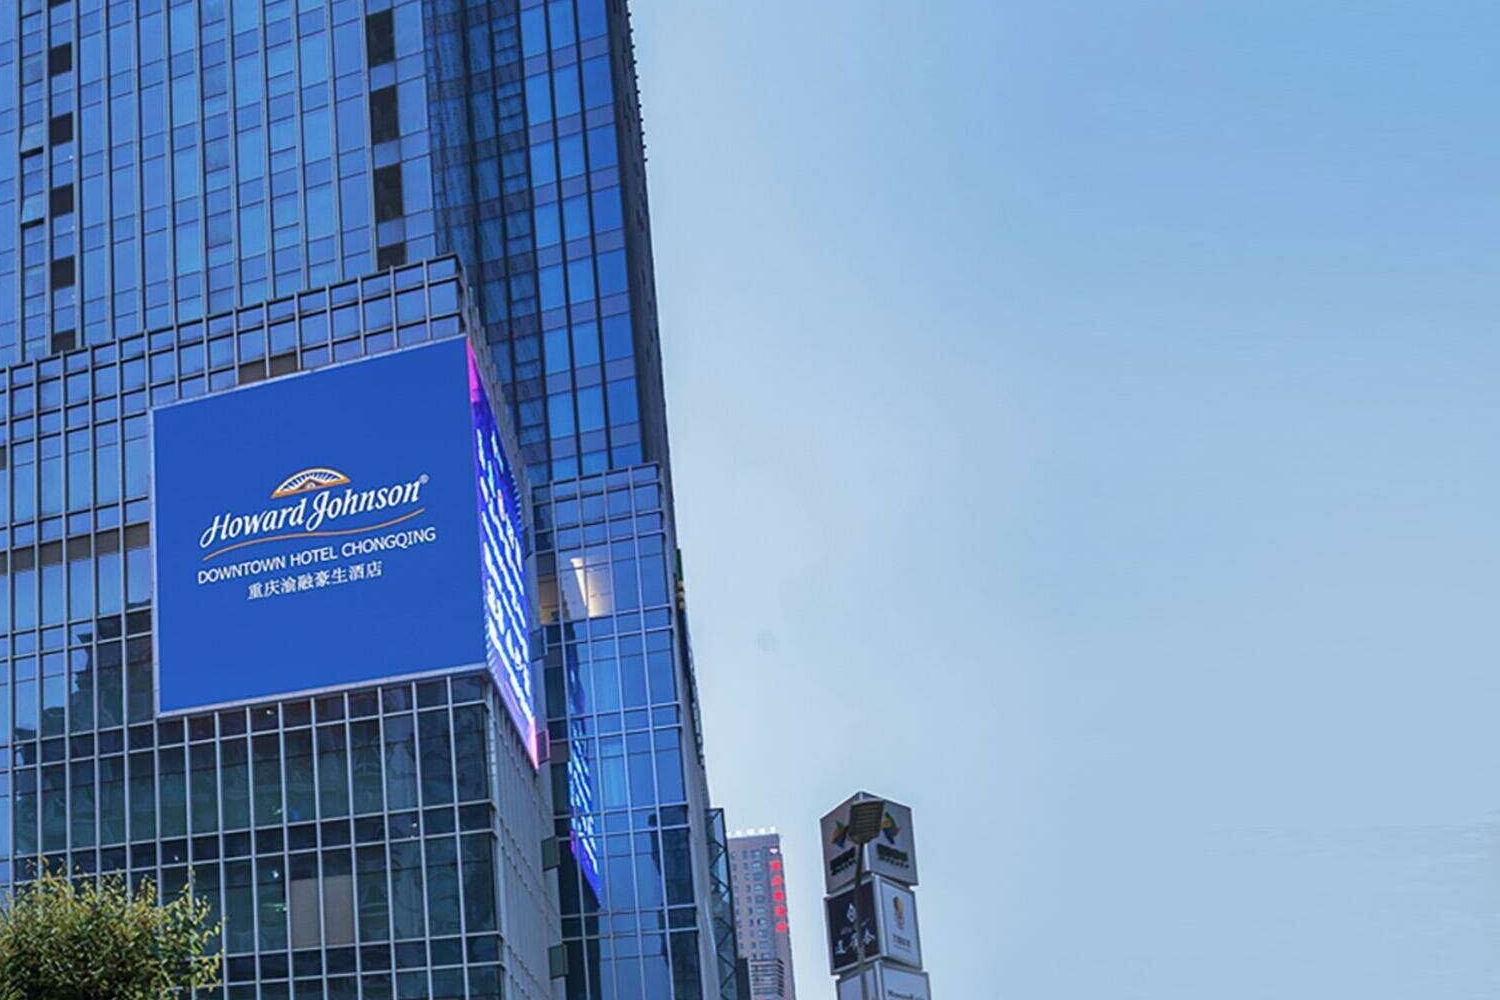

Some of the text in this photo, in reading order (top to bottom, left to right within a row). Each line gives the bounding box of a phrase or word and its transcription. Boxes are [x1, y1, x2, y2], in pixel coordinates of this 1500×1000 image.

[199, 482, 421, 548] Howard Johnson
[197, 526, 436, 585] DOWNTOWN HOTEL CHONGQING
[247, 560, 382, 600] 重庆渝融豪生酒店
